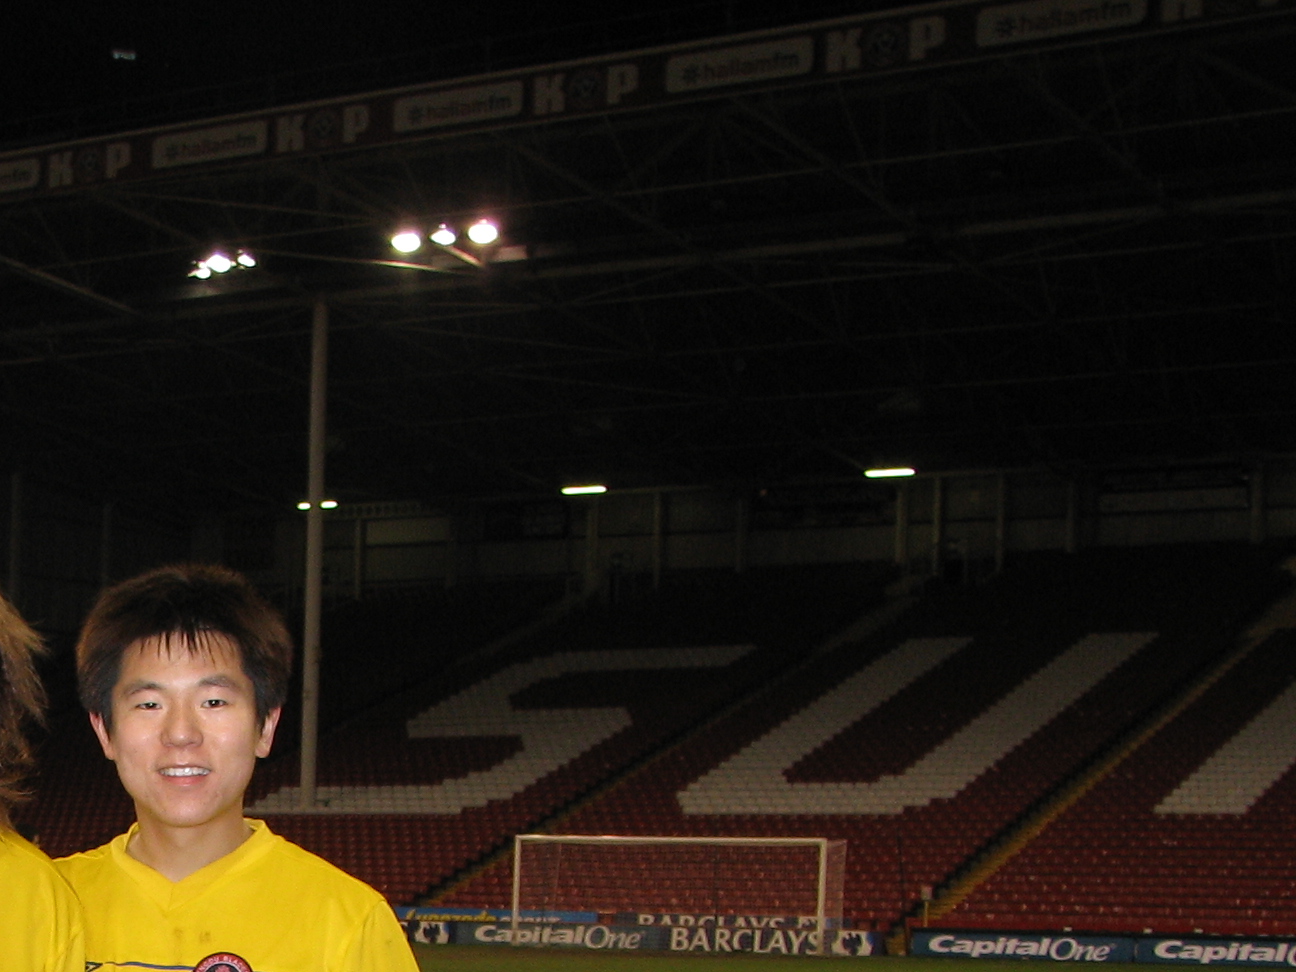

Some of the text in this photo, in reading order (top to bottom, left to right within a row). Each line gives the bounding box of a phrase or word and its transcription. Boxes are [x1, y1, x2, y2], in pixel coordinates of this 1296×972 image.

[474, 924, 642, 950] CapitalOne
[669, 926, 820, 956] BARCLAYS
[927, 934, 1112, 963] CapitalOne
[1153, 939, 1296, 965] Capital
